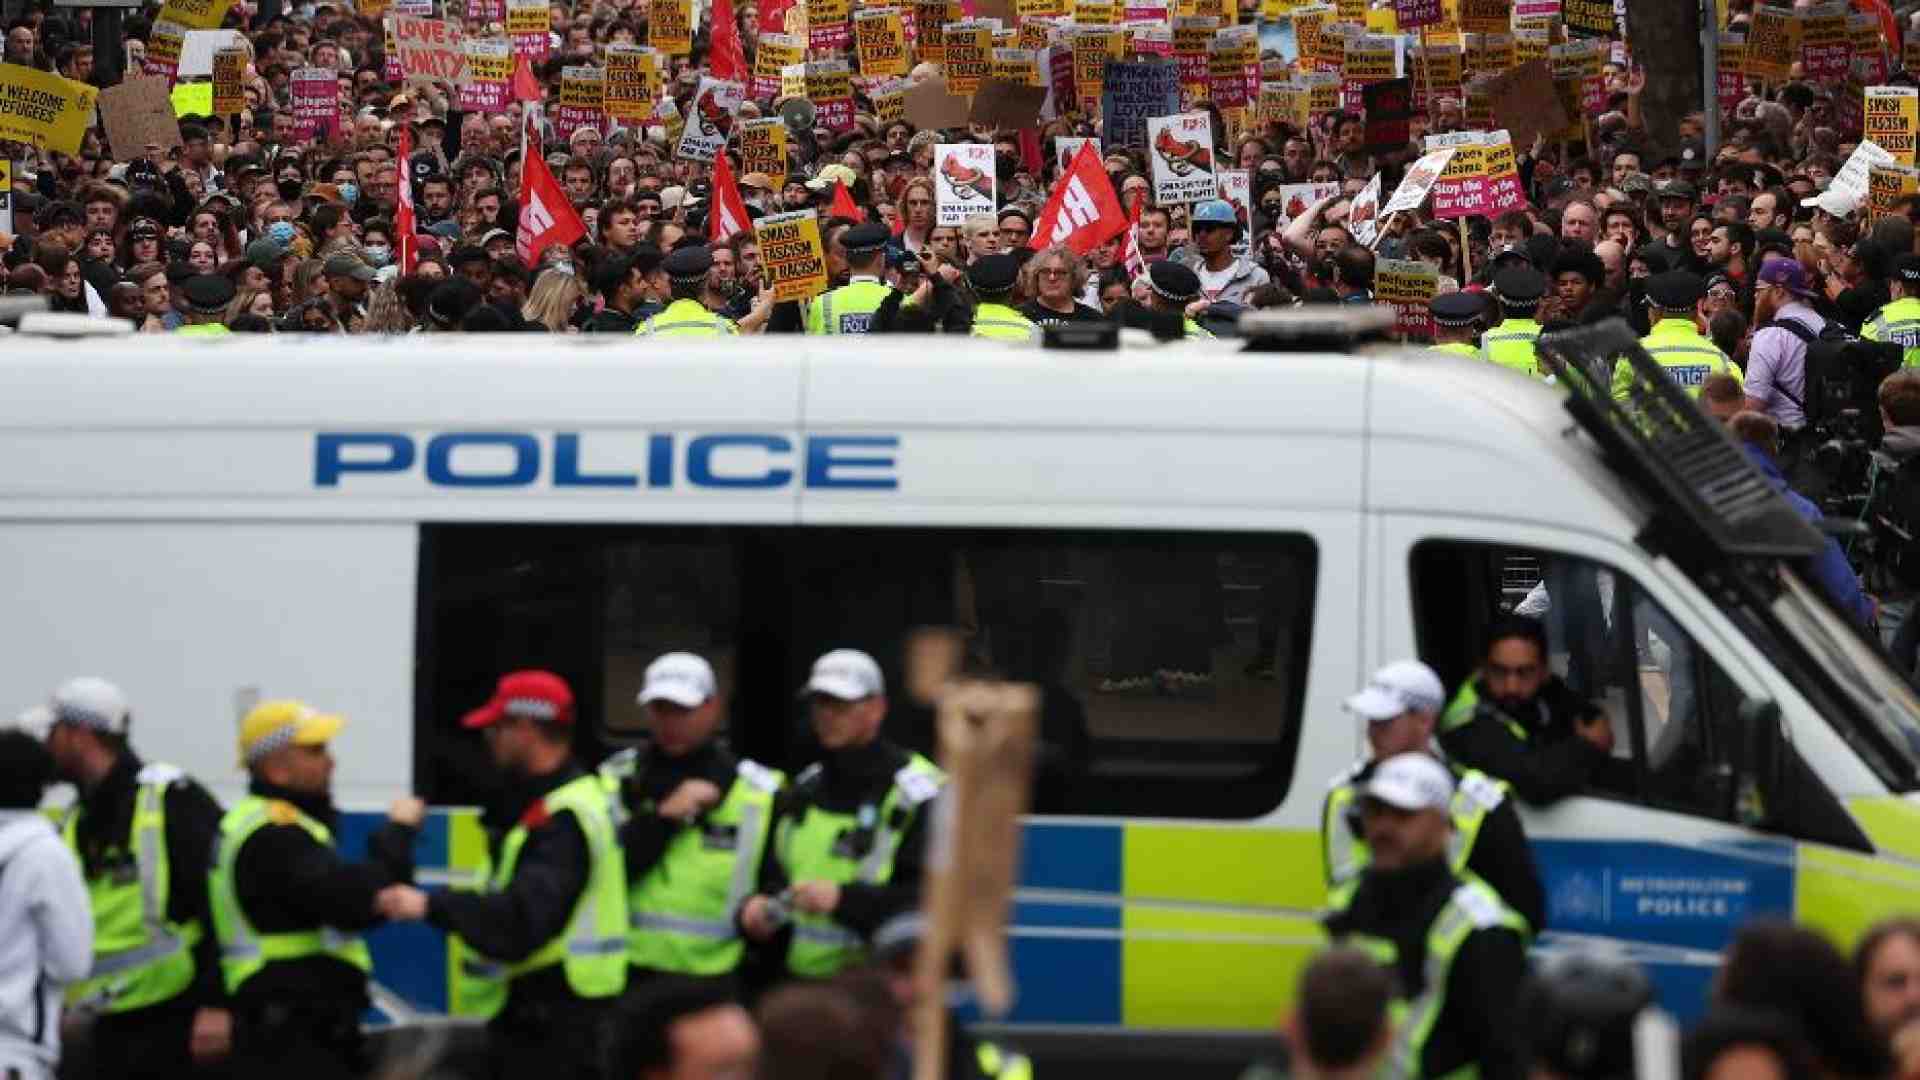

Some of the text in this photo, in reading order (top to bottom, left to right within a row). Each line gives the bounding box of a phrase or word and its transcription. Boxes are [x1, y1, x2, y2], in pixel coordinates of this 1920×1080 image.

[397, 17, 444, 43] LOVE
[401, 48, 464, 78] UNITY
[8, 83, 67, 111] WELCOME
[1867, 98, 1901, 112] SMASH
[1867, 116, 1909, 130] FASCISM
[1434, 180, 1483, 195] Stop the
[1435, 194, 1483, 209] far right
[758, 225, 801, 242] SMASH
[763, 240, 812, 261] FASCISM
[779, 257, 824, 279] RACISM
[1377, 271, 1435, 289] Refugees
[1377, 286, 1432, 299] welcome
[313, 432, 900, 489] POLICE
[1619, 878, 1747, 893] METROPOLITAN
[1637, 896, 1729, 917] POLICE
